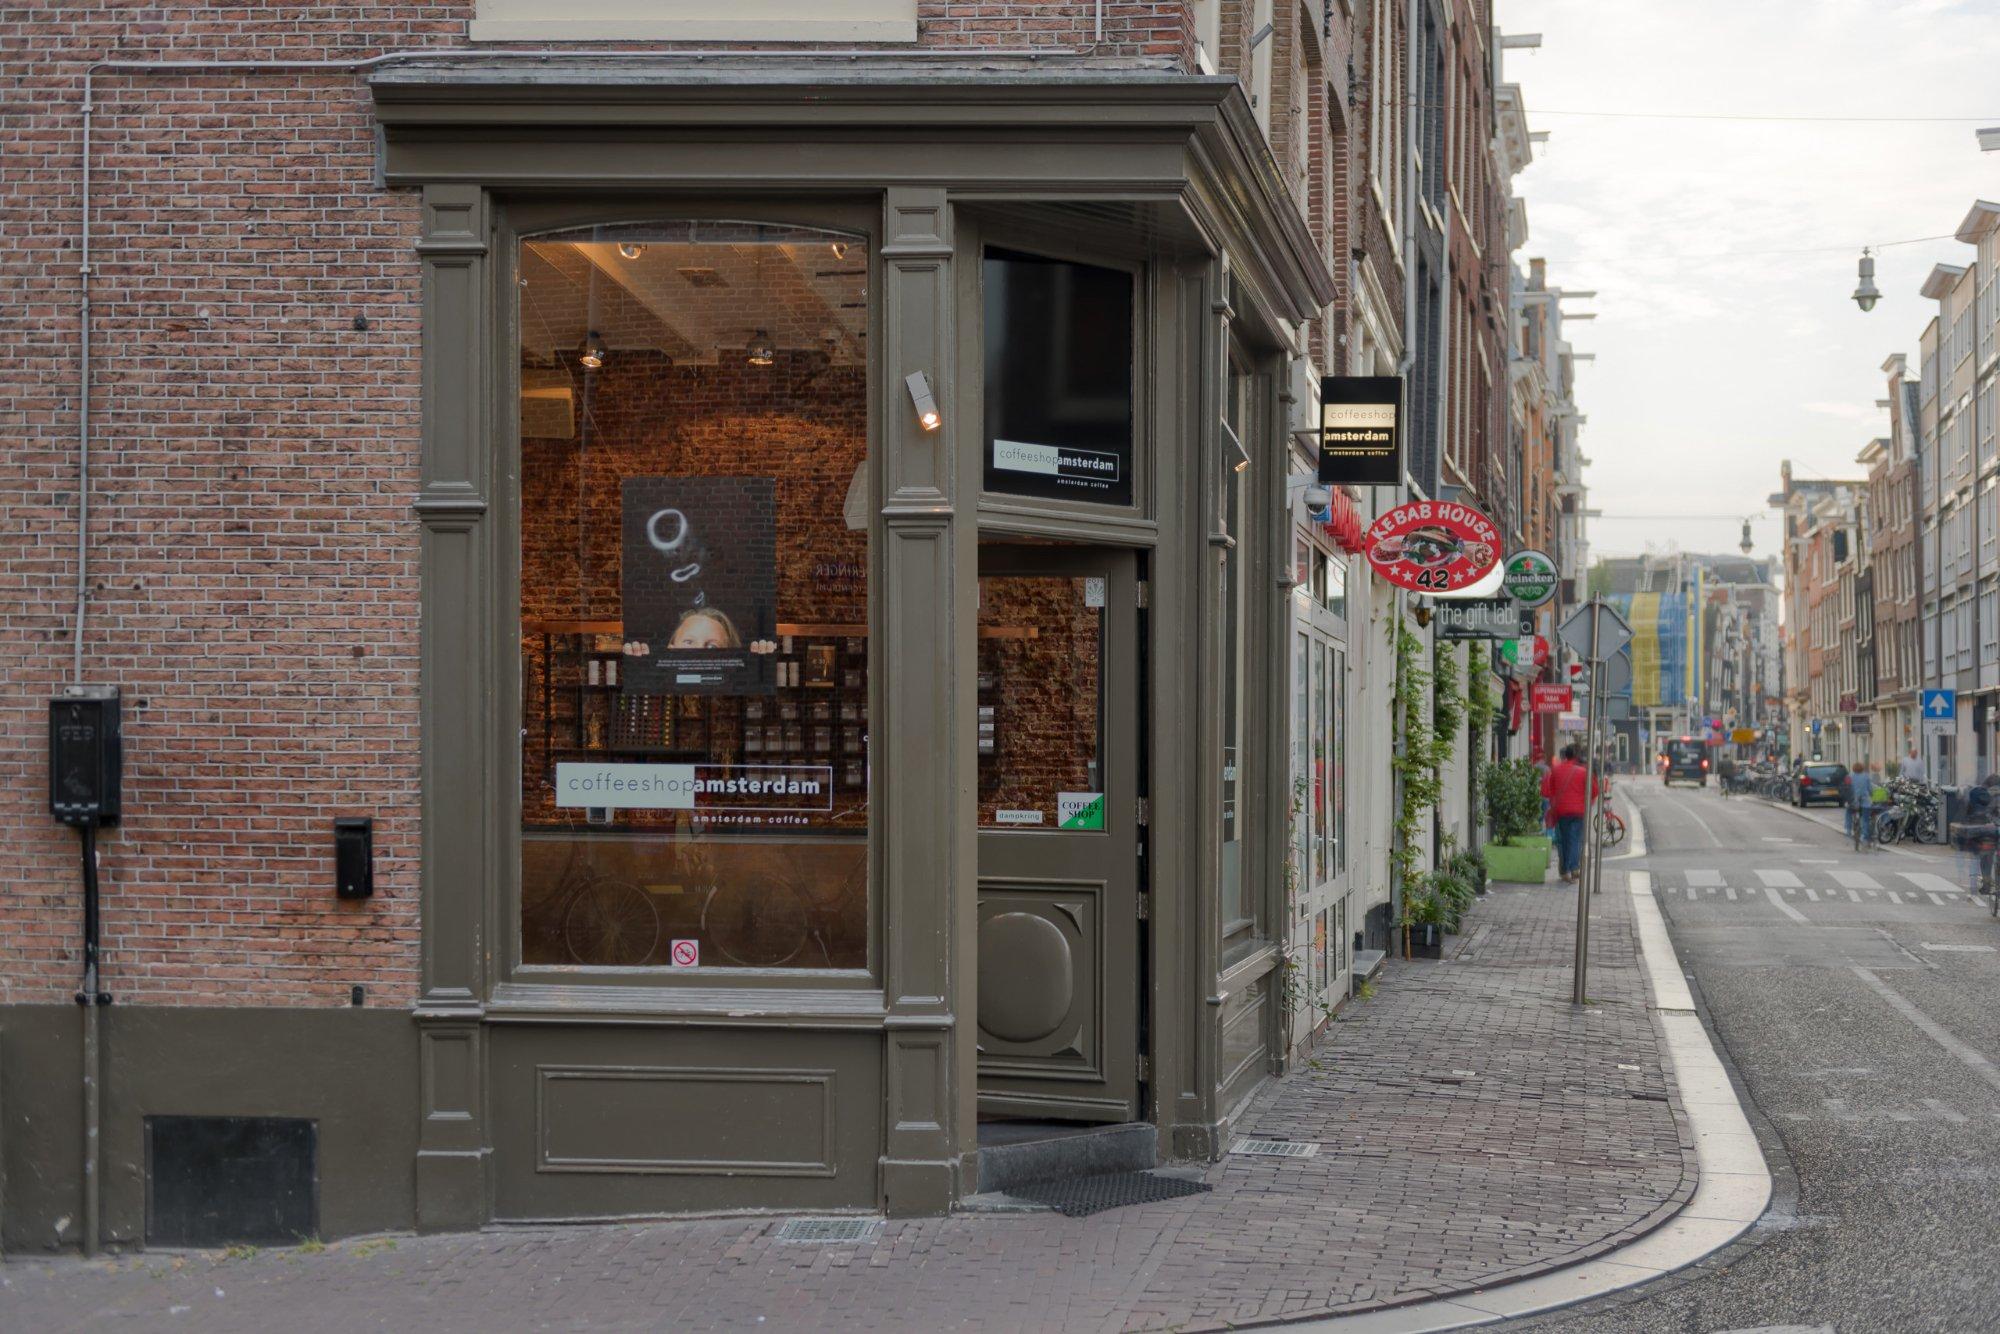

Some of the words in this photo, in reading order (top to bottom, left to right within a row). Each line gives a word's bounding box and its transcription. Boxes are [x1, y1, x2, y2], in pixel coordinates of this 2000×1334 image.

[1330, 408, 1396, 422] coffeeshop
[1324, 430, 1389, 441] amsterdam
[999, 448, 1058, 467] coffeeshop
[1058, 454, 1114, 471] amsterdam
[1057, 478, 1088, 487] amsterdam
[1371, 503, 1432, 540] KEBAB
[1438, 503, 1496, 542] HOUSE
[1416, 568, 1449, 589] 42
[1504, 573, 1554, 583] Heineken
[1440, 602, 1462, 625] the
[1466, 602, 1489, 630] gift
[1493, 602, 1517, 625] lab.
[568, 772, 695, 797] coffeeshop
[693, 775, 820, 795] amsterdam
[1062, 801, 1099, 810] COFFEE
[693, 814, 762, 824] amsterdam
[768, 815, 809, 824] coffee
[999, 812, 1040, 821] dampkring
[1068, 810, 1095, 819] SHOP
